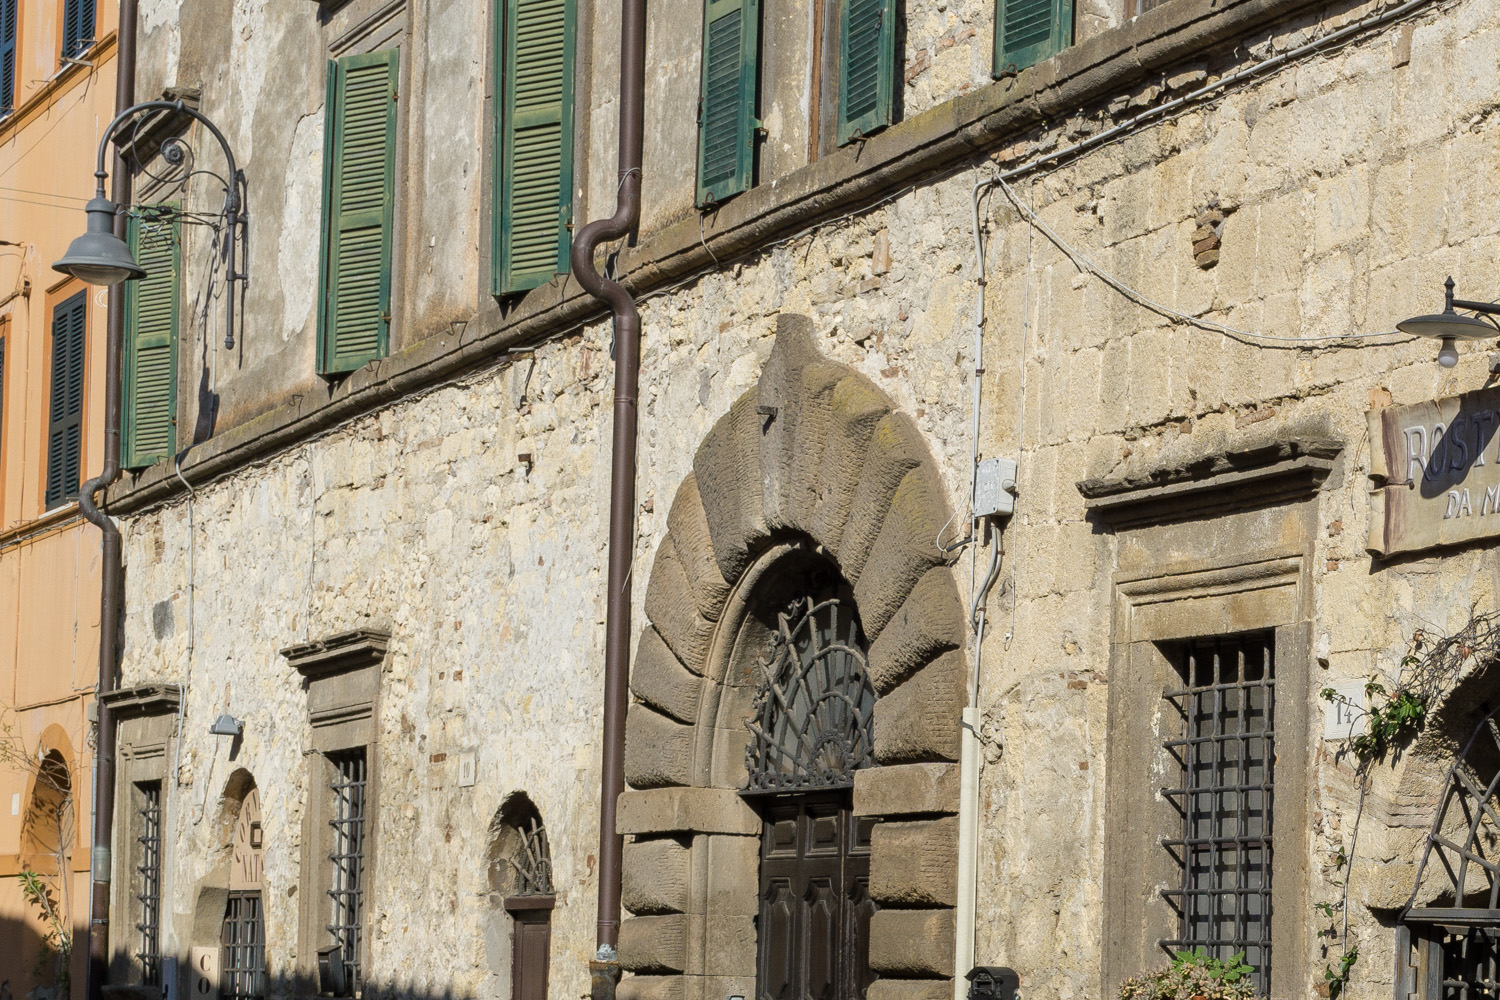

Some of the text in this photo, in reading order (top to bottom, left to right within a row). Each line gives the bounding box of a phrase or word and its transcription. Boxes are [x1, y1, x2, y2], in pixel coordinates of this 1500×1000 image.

[1443, 487, 1472, 519] DA
[1335, 697, 1353, 725] 14
[463, 761, 471, 779] 10
